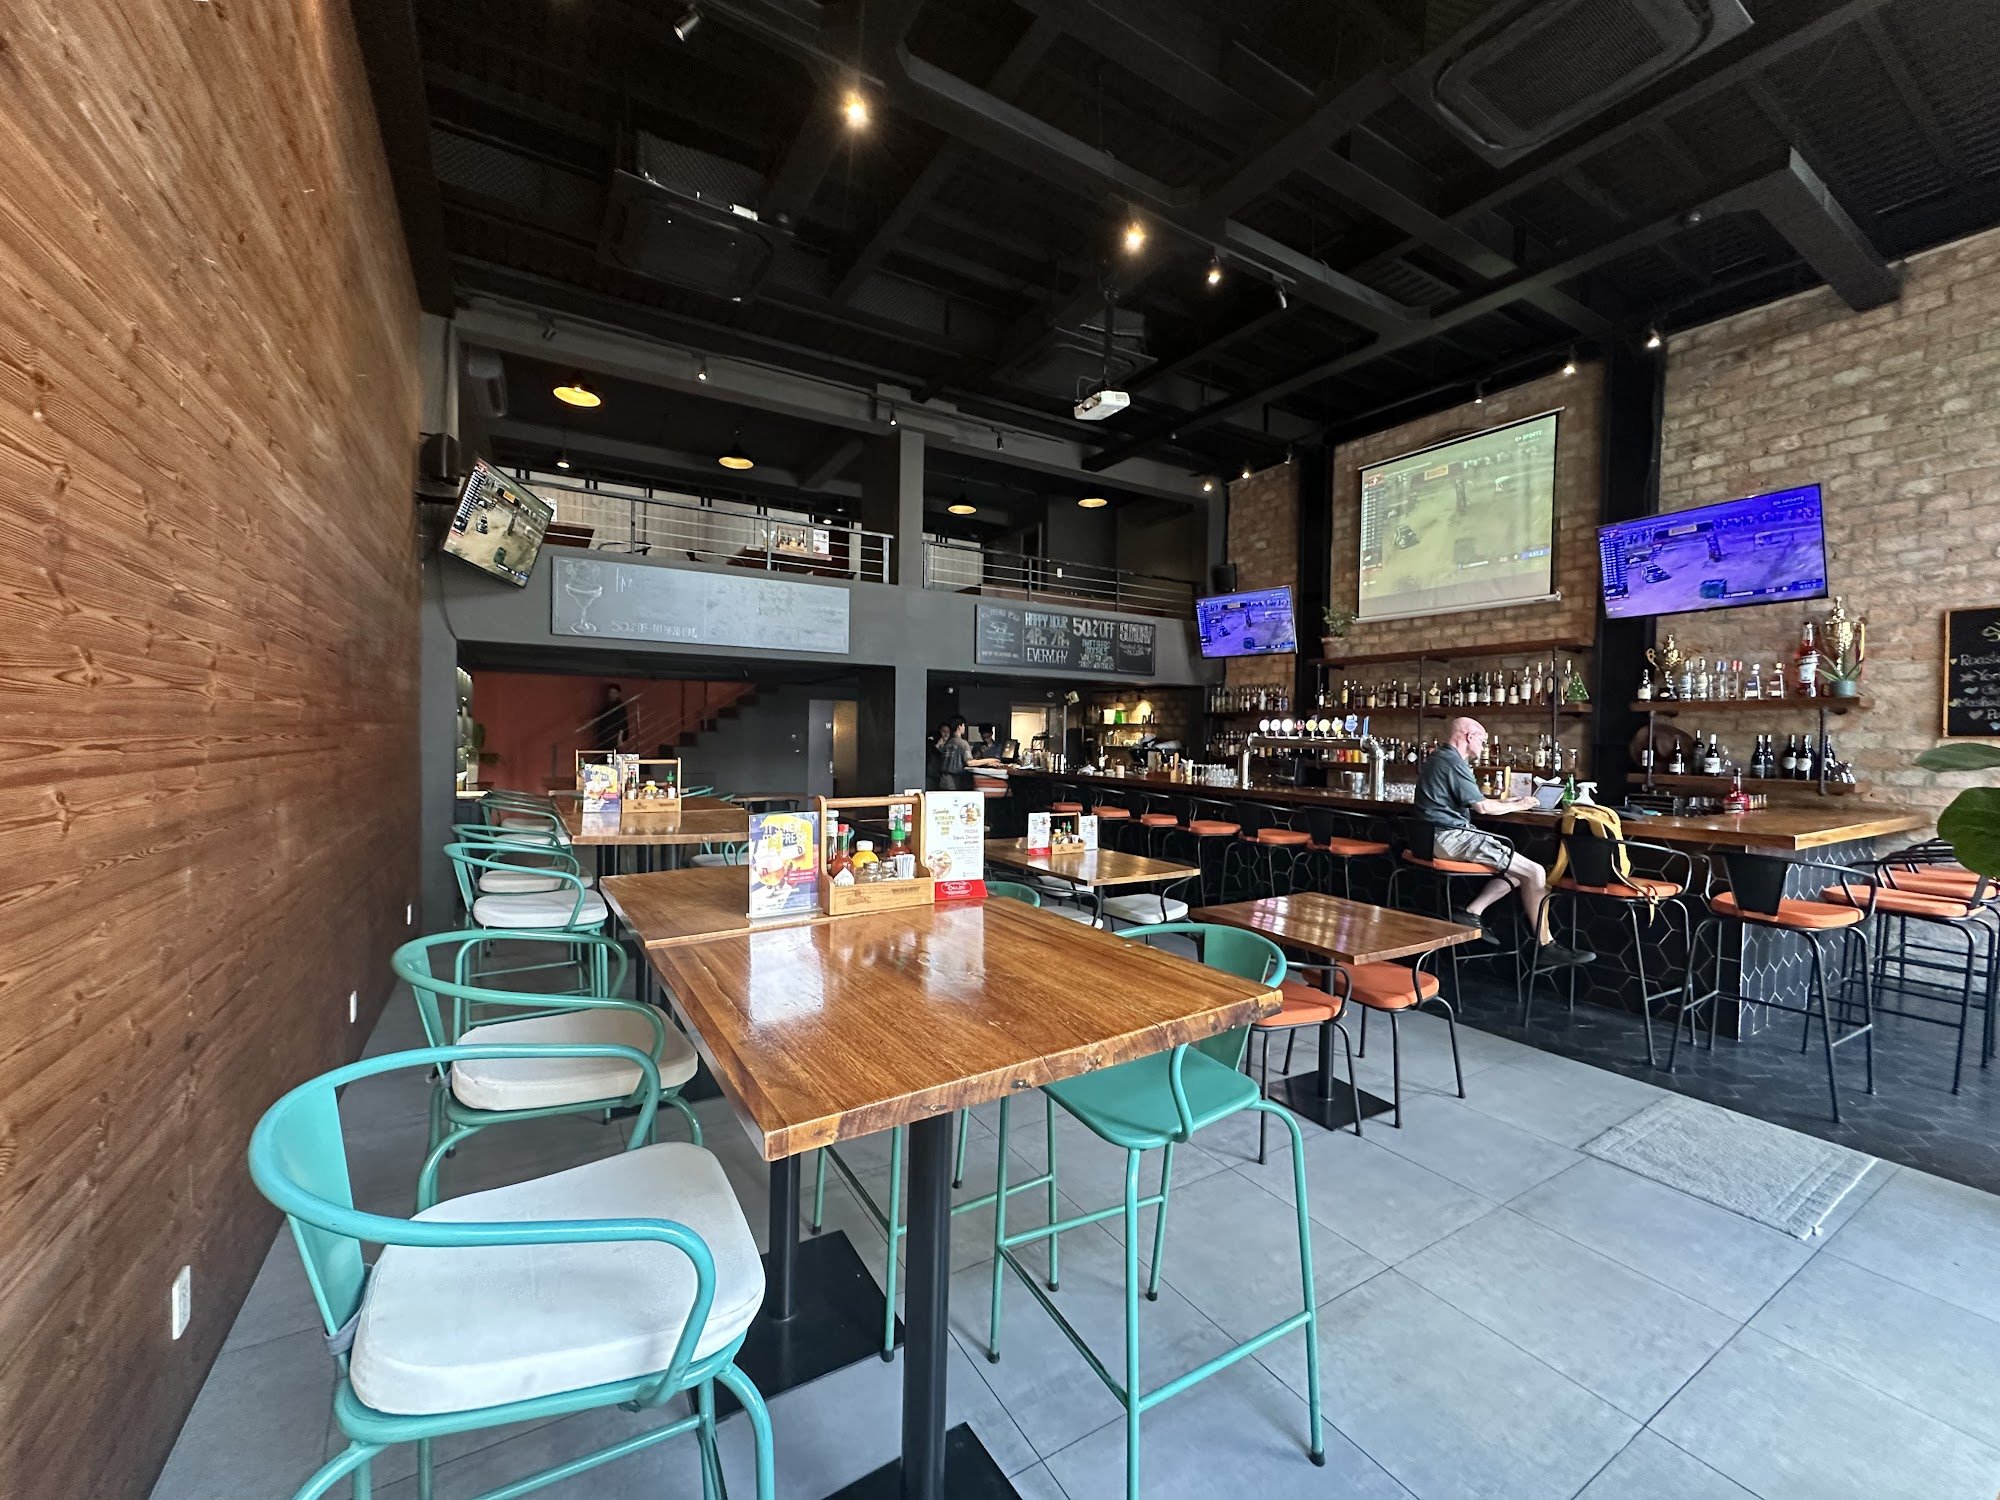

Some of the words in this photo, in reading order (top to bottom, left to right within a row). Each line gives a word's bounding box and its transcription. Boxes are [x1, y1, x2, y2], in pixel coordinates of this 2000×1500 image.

[1024, 611, 1048, 628] HAPPY
[1049, 614, 1068, 629] HOUR
[1072, 617, 1101, 638] 50%
[1099, 621, 1117, 639] OFF
[1027, 647, 1068, 664] EVERYDAY
